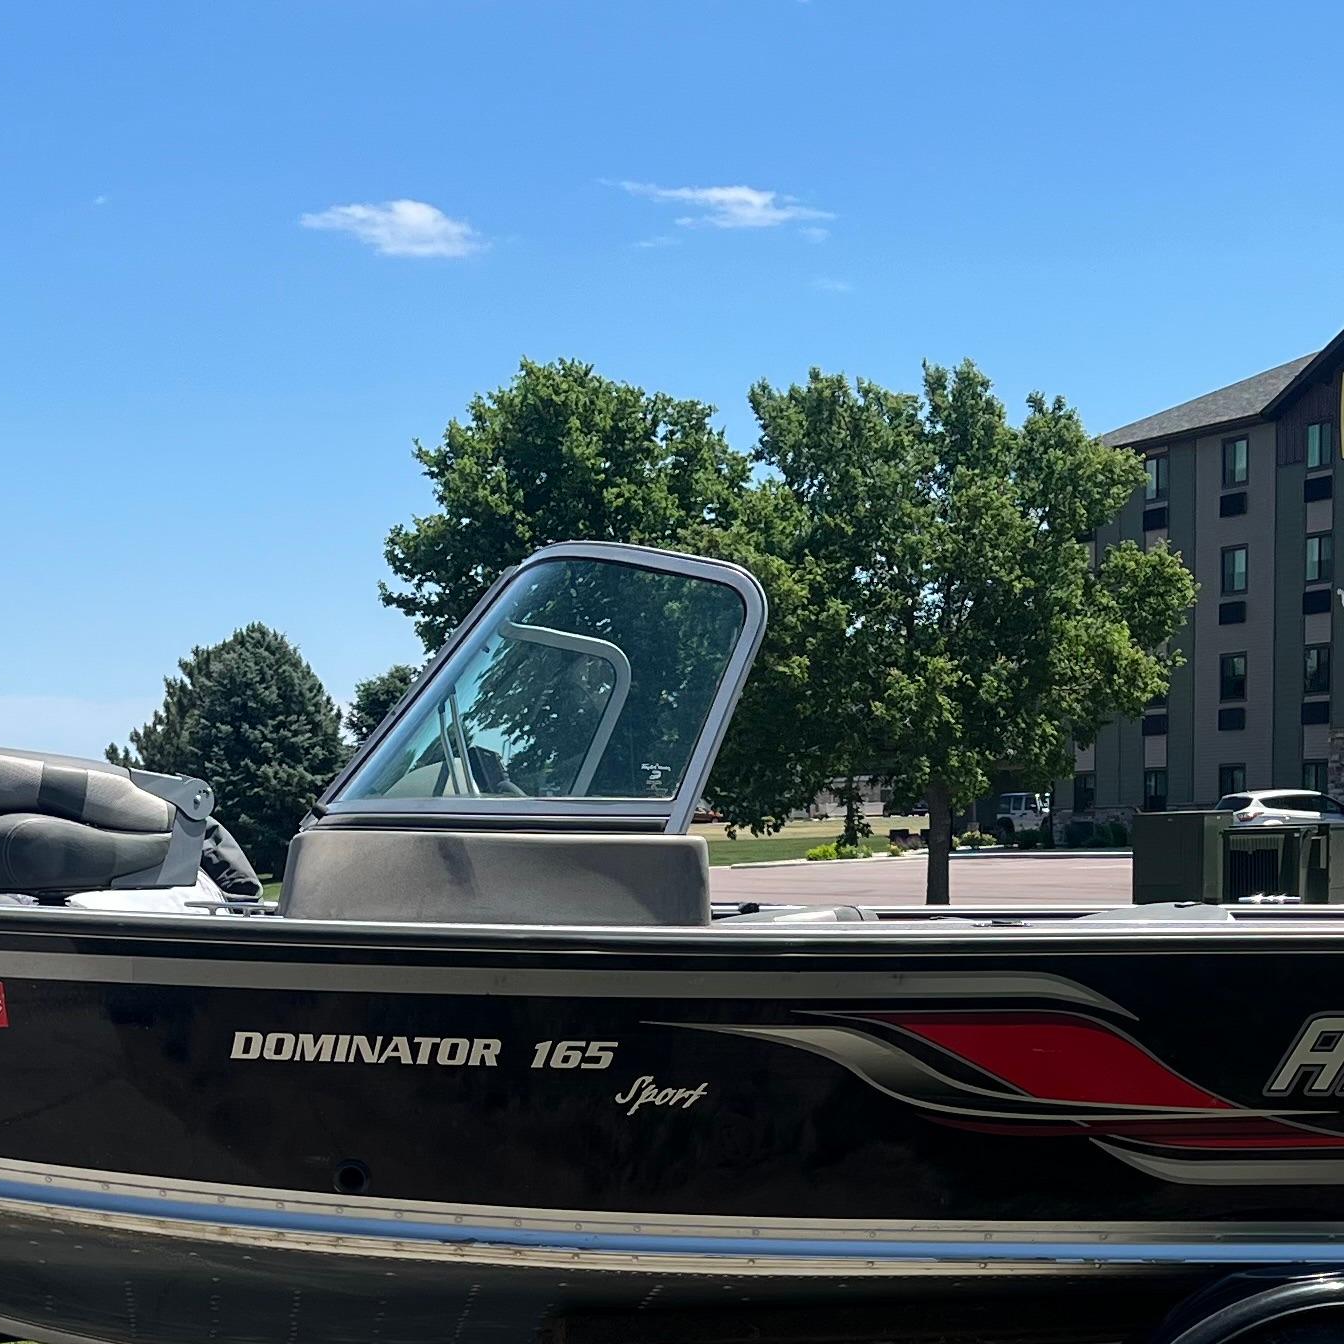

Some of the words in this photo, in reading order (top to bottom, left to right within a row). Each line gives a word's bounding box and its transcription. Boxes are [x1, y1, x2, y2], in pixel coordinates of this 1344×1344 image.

[229, 1031, 502, 1068] DOMINATOR
[531, 1041, 619, 1069] 165
[614, 1075, 709, 1116] Sport
